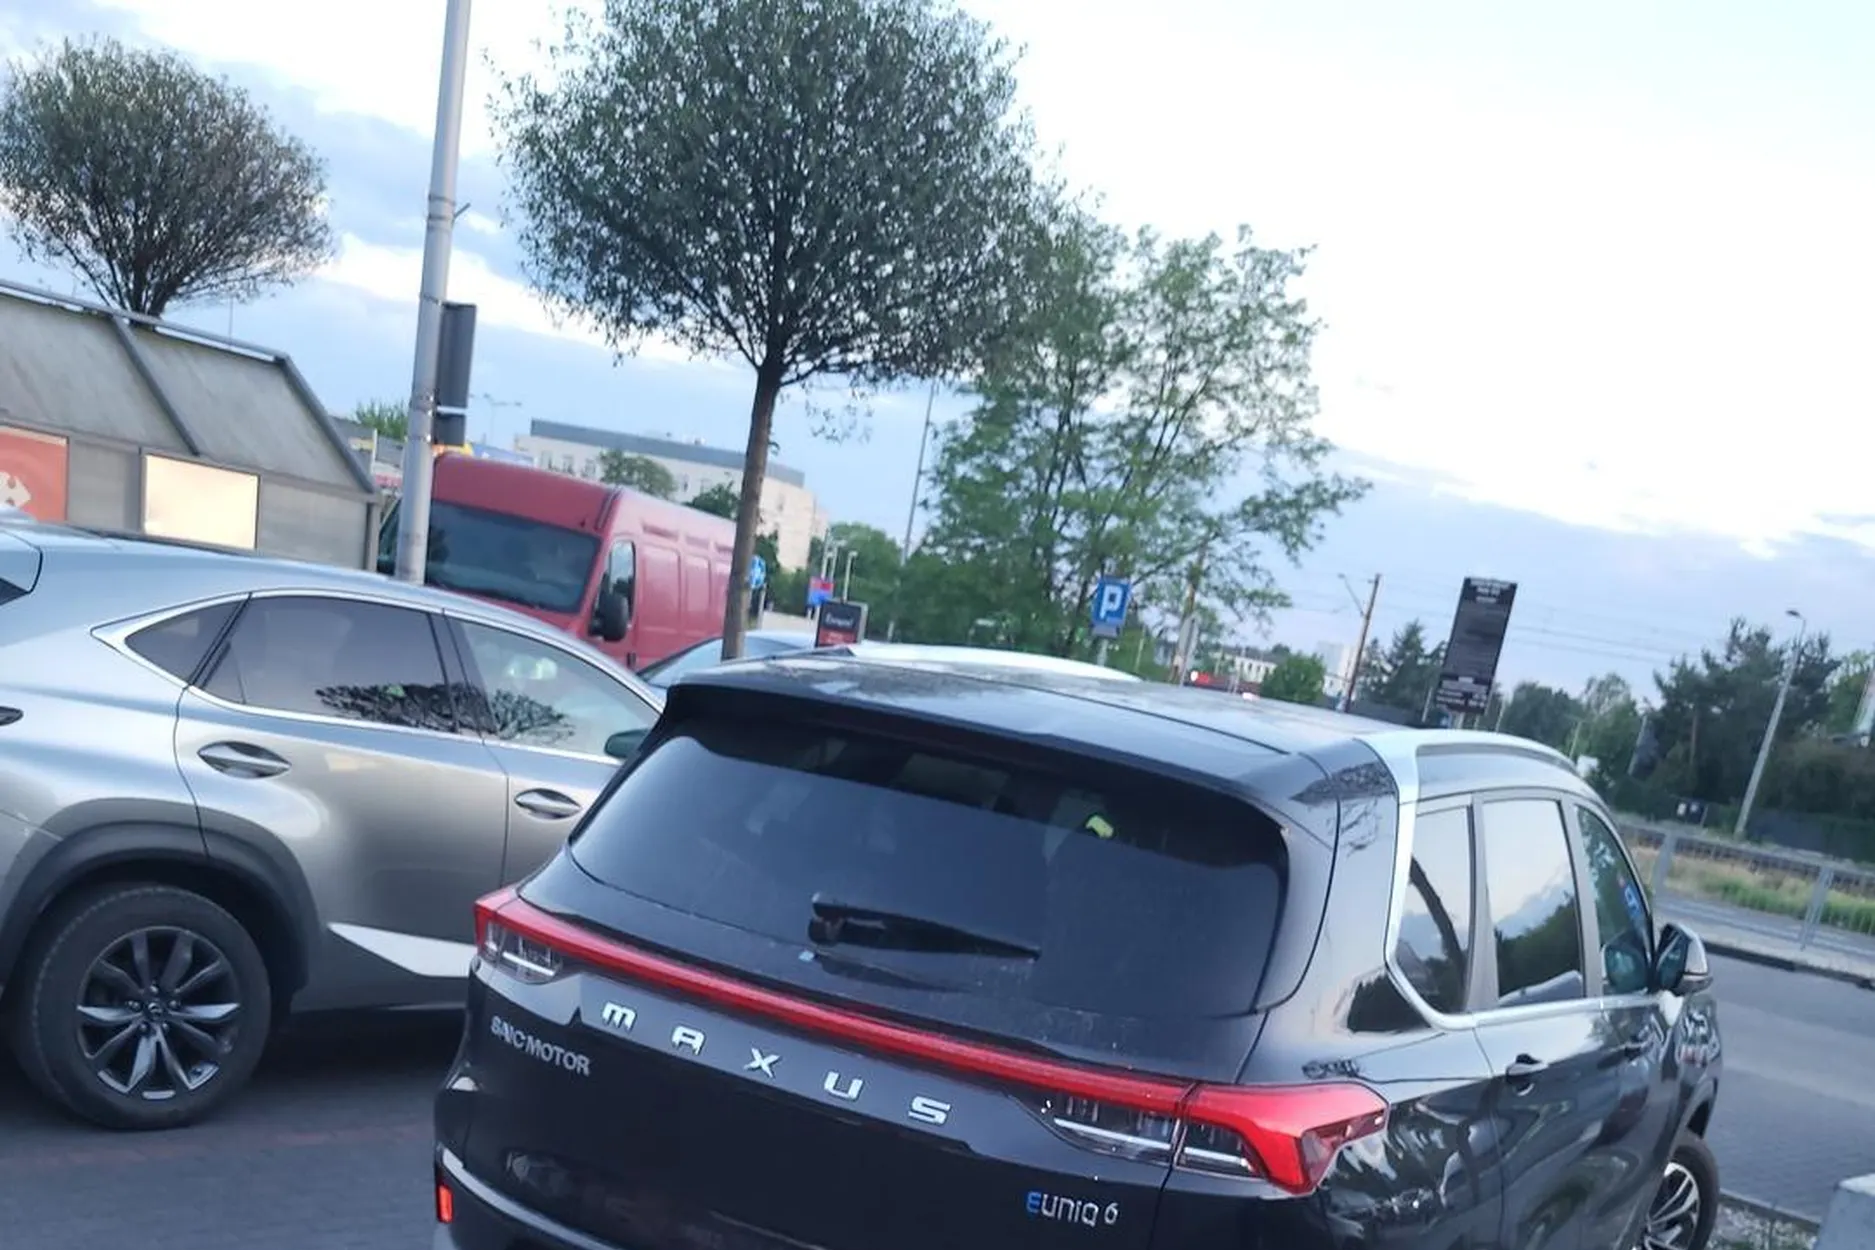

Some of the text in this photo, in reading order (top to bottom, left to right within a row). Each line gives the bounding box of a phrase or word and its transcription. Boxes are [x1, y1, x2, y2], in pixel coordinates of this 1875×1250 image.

[1099, 584, 1124, 619] P
[490, 1015, 591, 1076] SAIC MOTOR
[602, 1001, 951, 1125] MAXUS
[1104, 1202, 1119, 1225] 6
